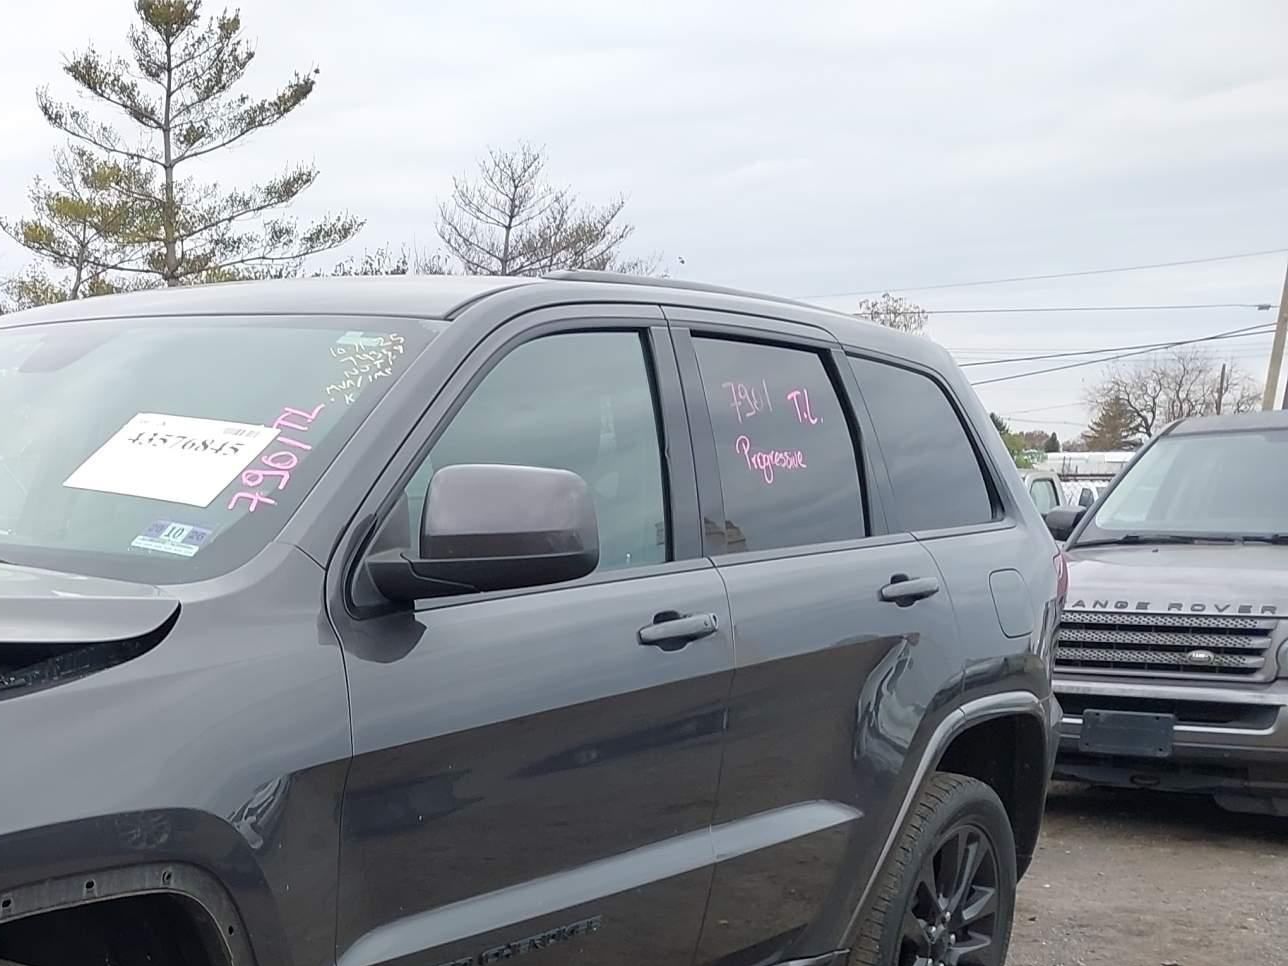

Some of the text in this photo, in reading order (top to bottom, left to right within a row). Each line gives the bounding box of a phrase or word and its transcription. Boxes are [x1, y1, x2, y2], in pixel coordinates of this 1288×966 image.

[127, 431, 247, 456] 43576845
[163, 525, 185, 540] 10
[1070, 598, 1279, 616] ANGE ROVER
